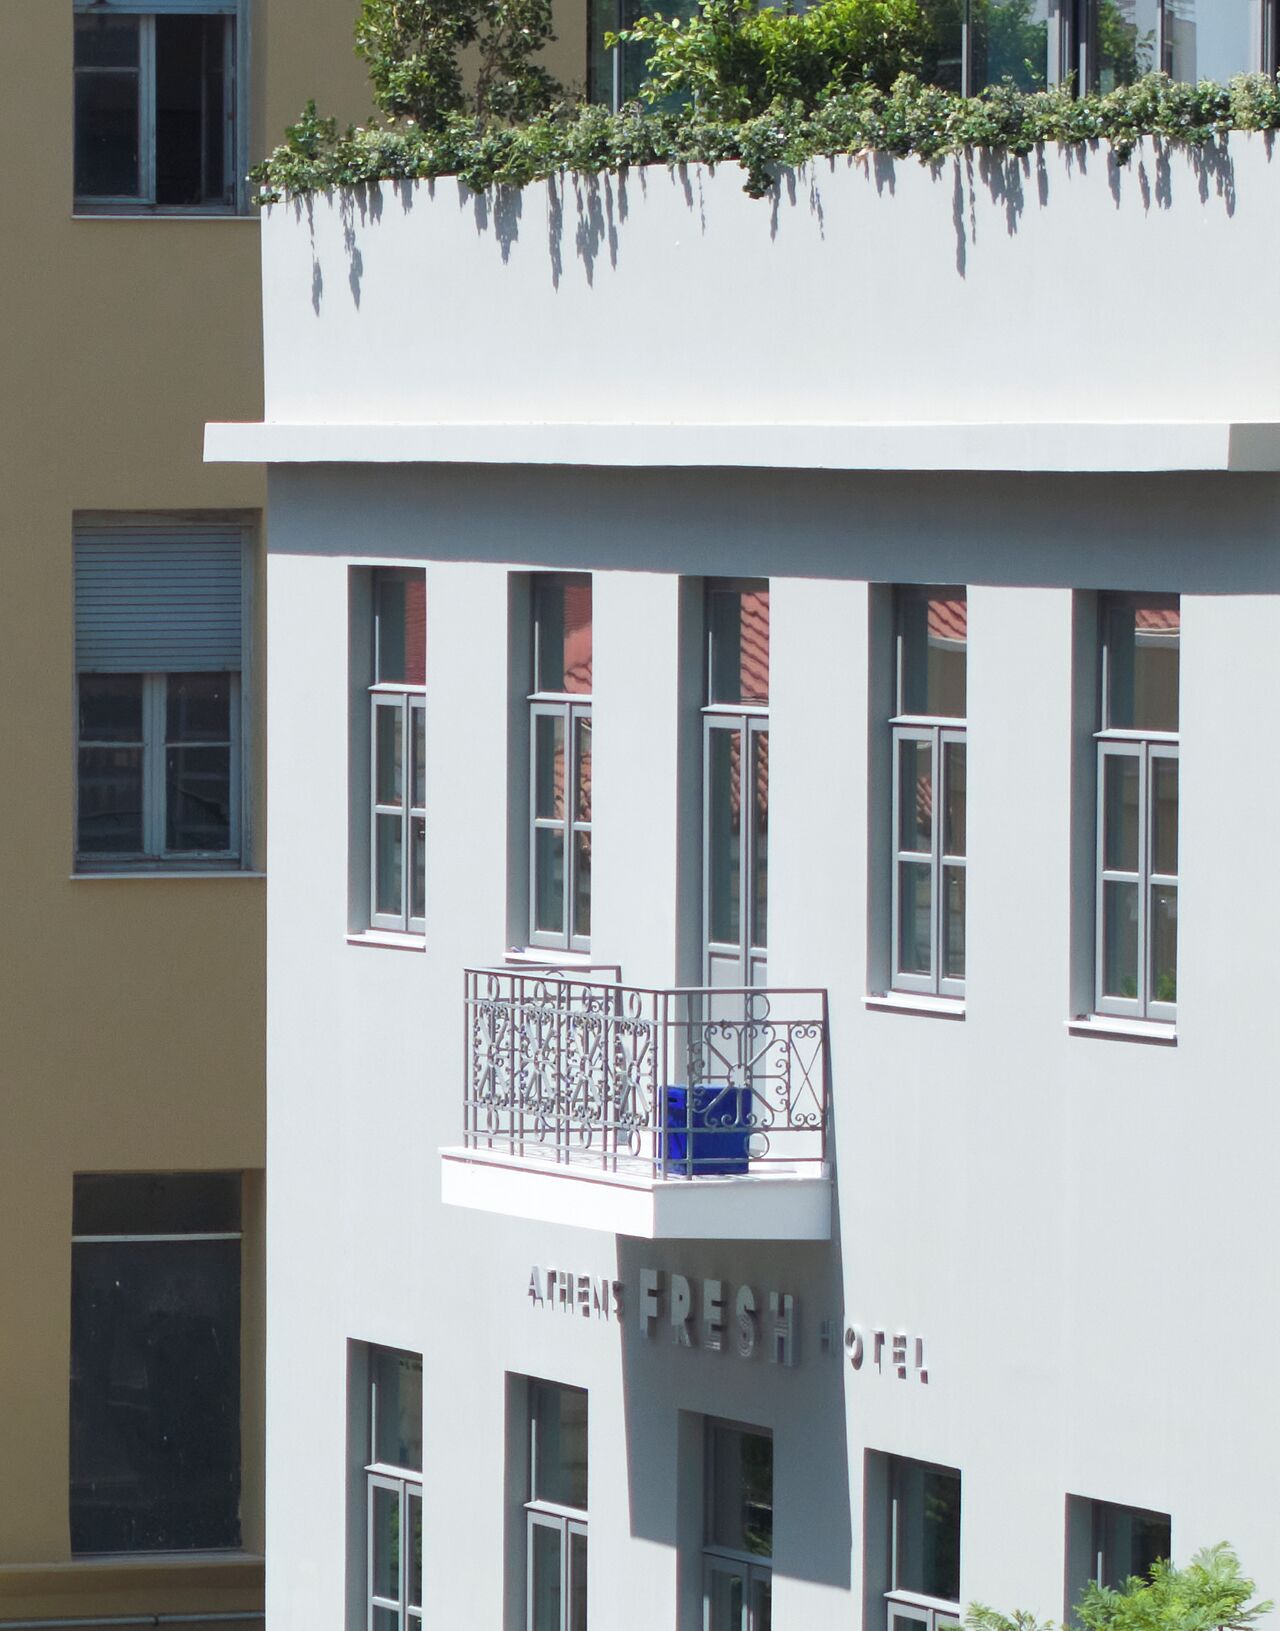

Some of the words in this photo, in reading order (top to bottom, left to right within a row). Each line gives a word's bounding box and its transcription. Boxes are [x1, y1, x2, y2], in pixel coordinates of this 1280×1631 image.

[528, 1266, 624, 1323] ATHENS
[639, 1268, 800, 1368] FRESH
[820, 1318, 929, 1385] HOTEL
